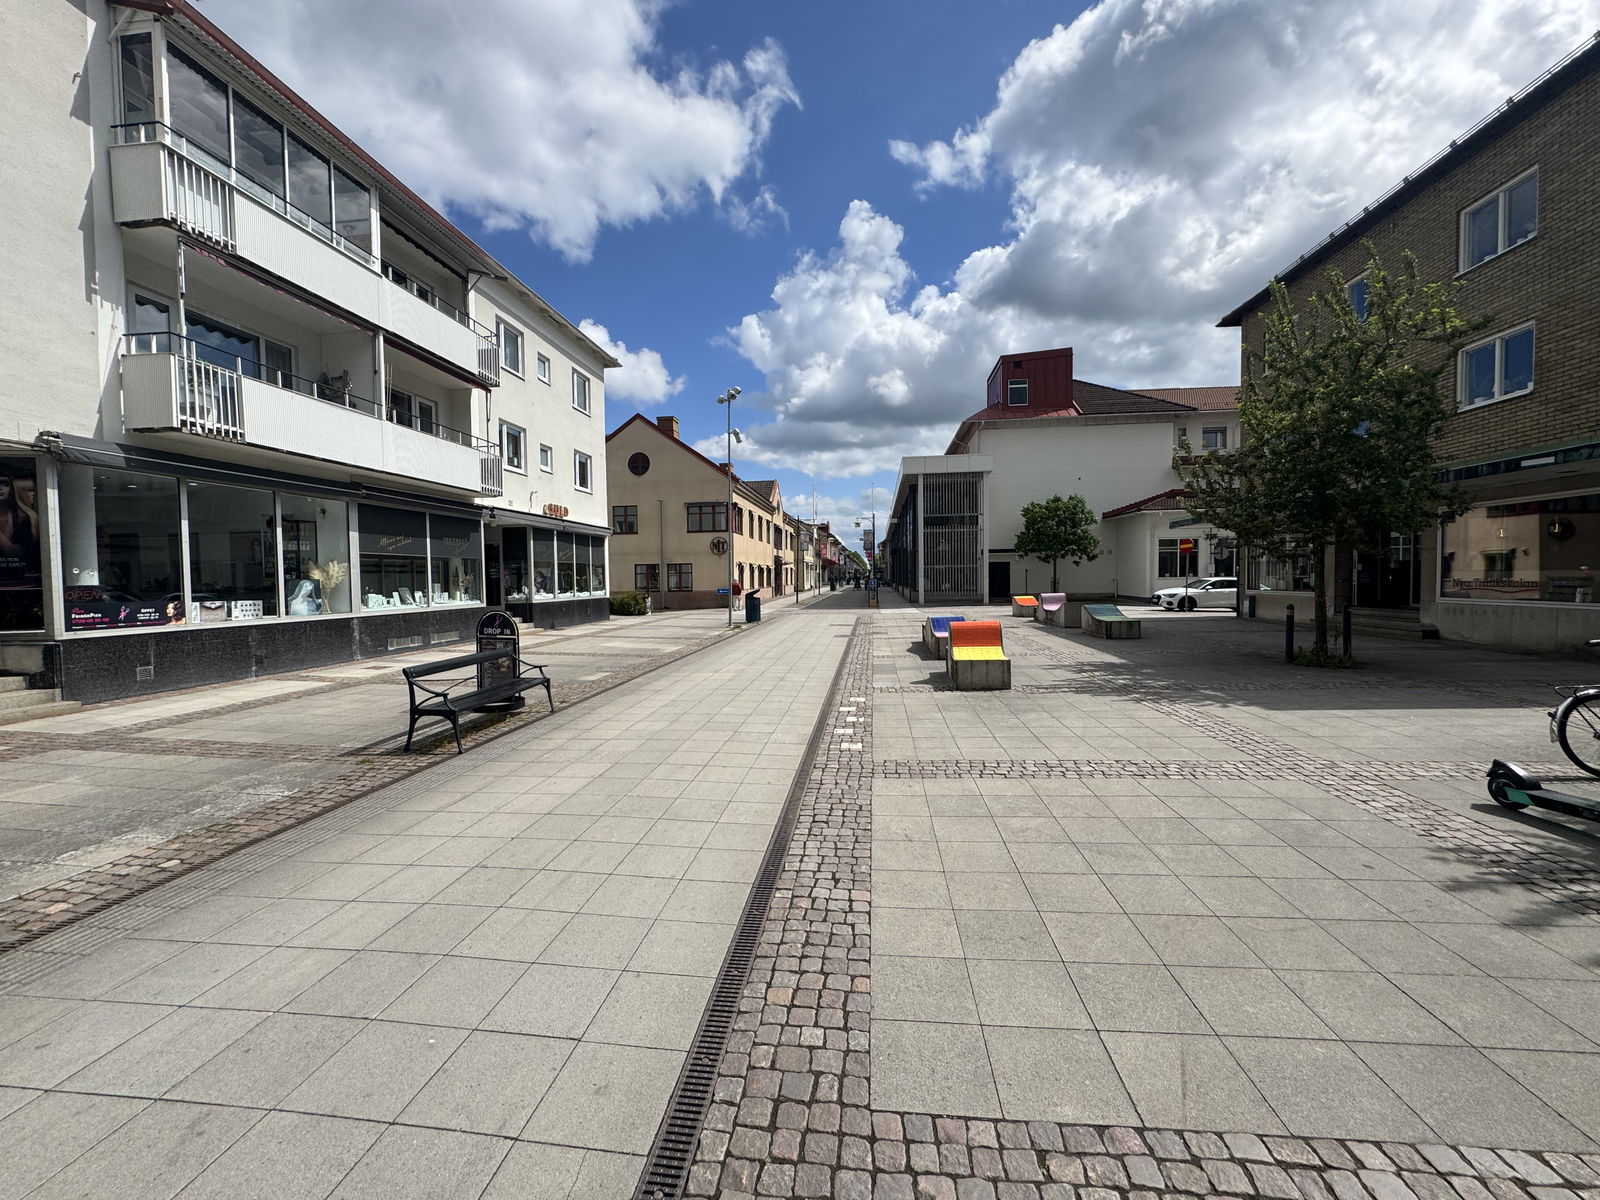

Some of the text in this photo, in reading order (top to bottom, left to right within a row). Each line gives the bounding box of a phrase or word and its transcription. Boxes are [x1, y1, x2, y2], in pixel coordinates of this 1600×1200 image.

[1452, 578, 1472, 590] Nya
[65, 590, 101, 600] OPEN
[484, 627, 501, 635] DROP
